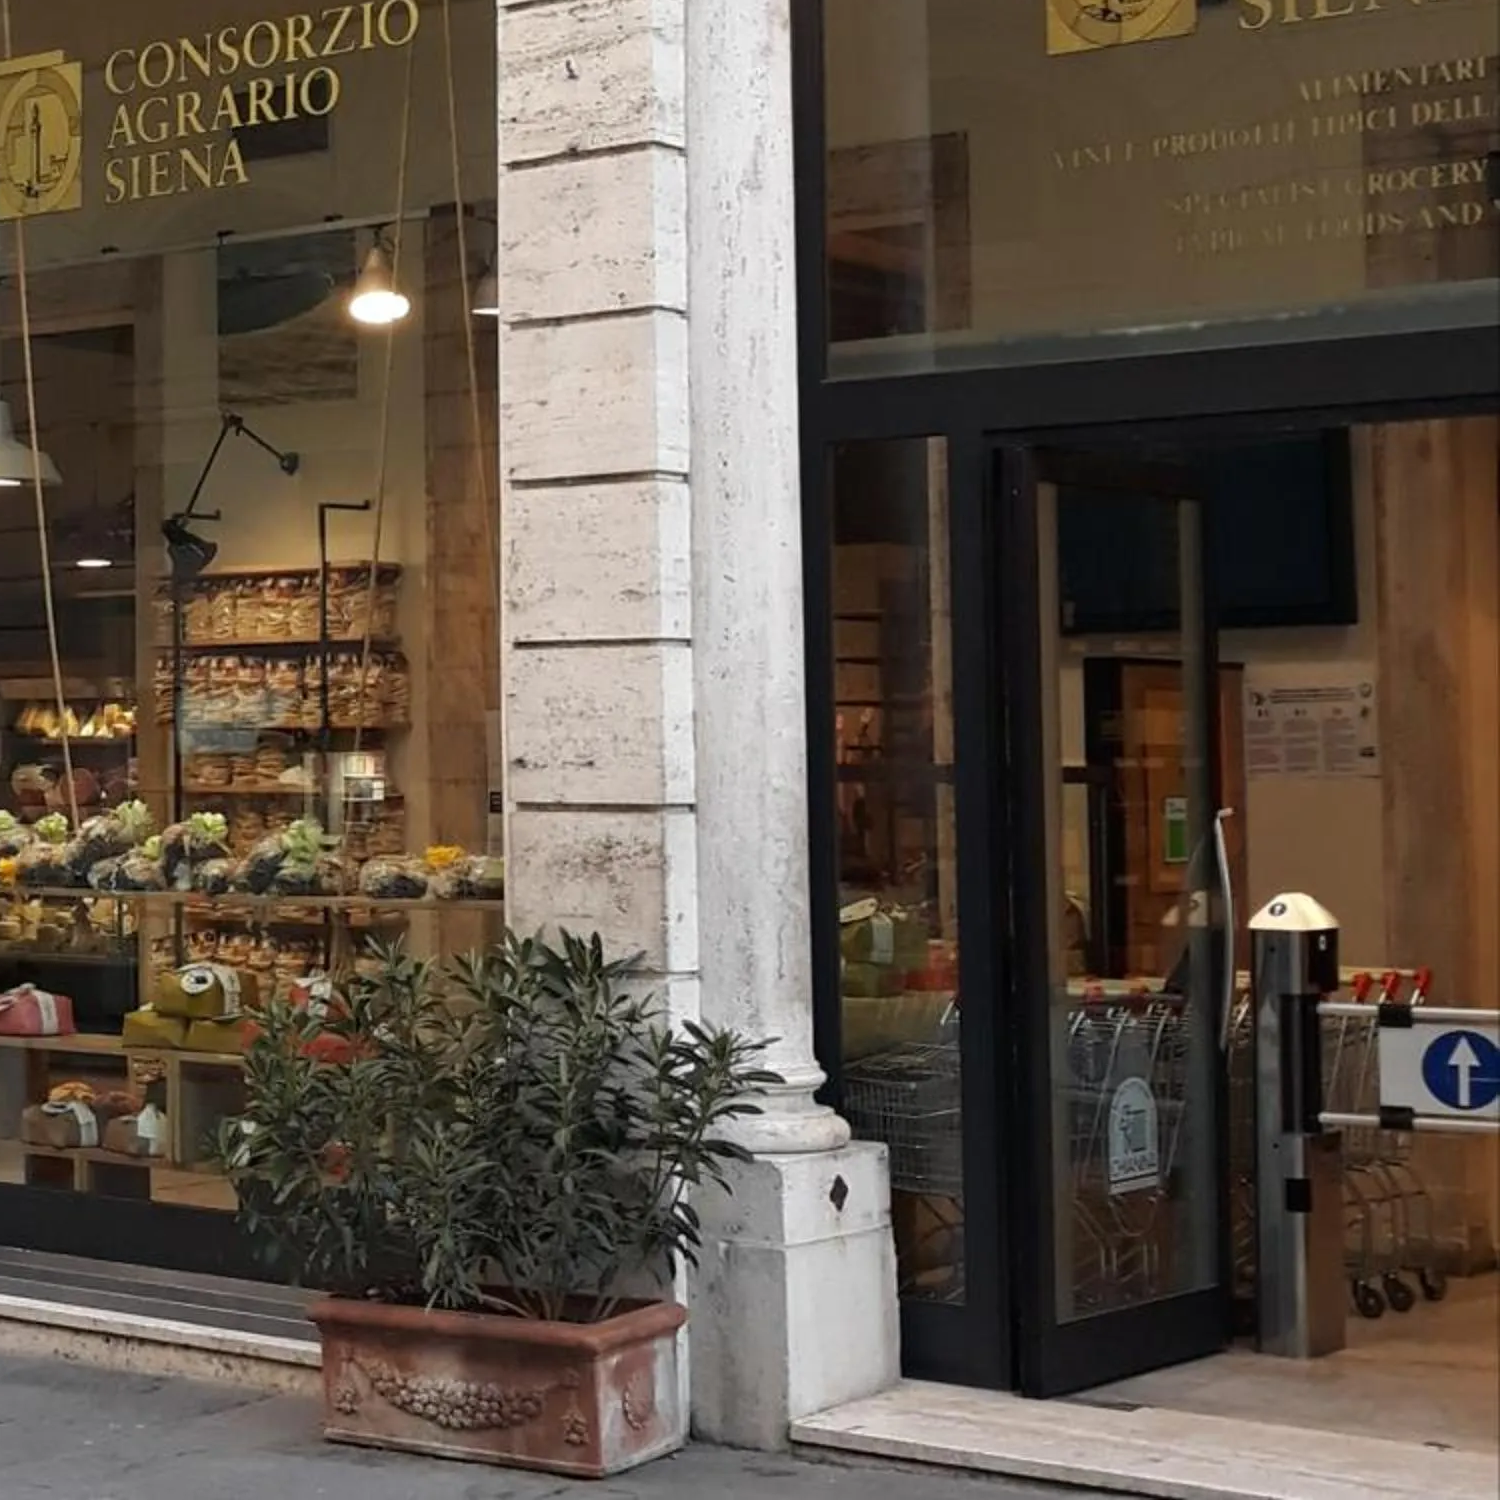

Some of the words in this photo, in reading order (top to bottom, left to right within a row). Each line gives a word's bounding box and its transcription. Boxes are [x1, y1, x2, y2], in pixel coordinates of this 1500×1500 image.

[1300, 55, 1486, 102] ALIMENTARI
[107, 66, 341, 149] AGRARIO
[105, 137, 250, 204] SIENA
[1344, 158, 1488, 196] GROCERY
[1419, 201, 1484, 229] AND
